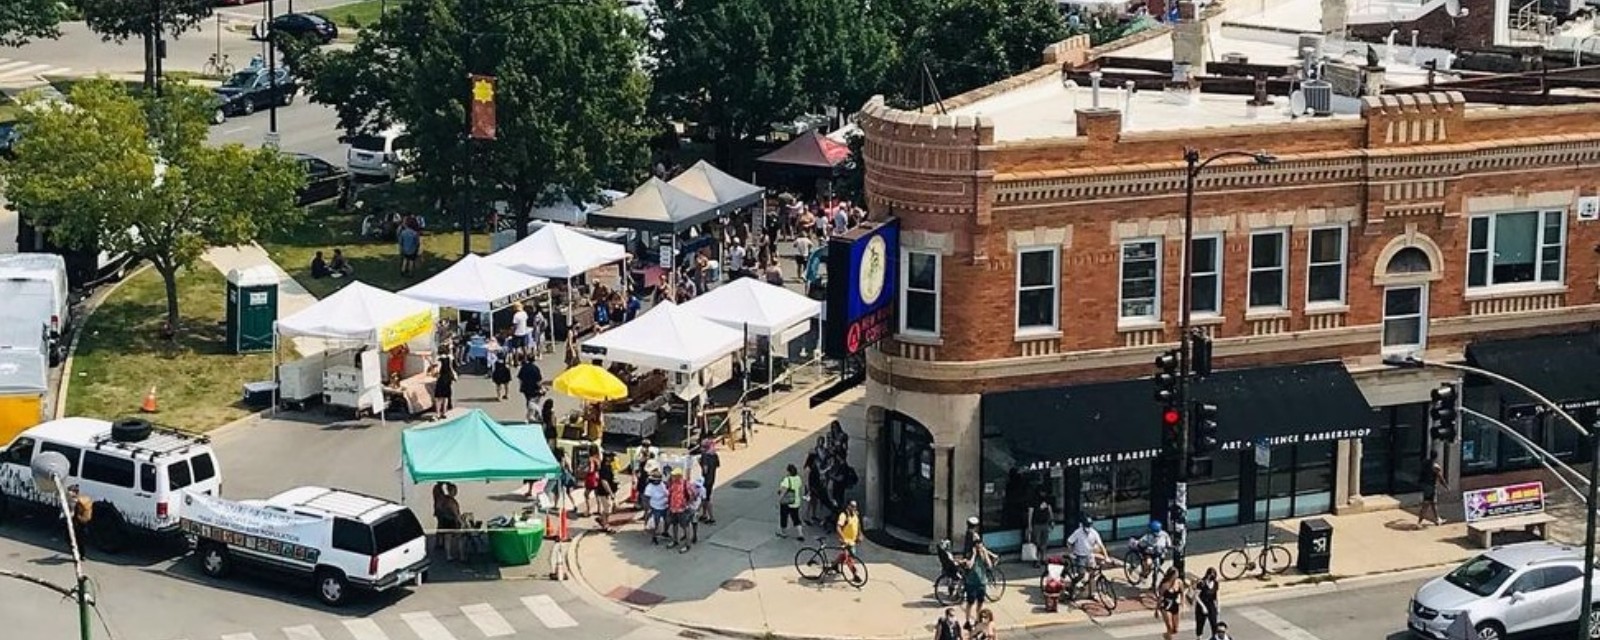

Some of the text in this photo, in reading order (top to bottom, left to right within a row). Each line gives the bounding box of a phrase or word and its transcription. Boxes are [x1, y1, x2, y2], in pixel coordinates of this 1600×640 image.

[1222, 441, 1242, 450] ART
[1304, 428, 1371, 442] BARBERSHOP
[1030, 461, 1051, 471] ART
[1067, 454, 1112, 467] SCIENCE
[1117, 449, 1163, 461] BARBER
